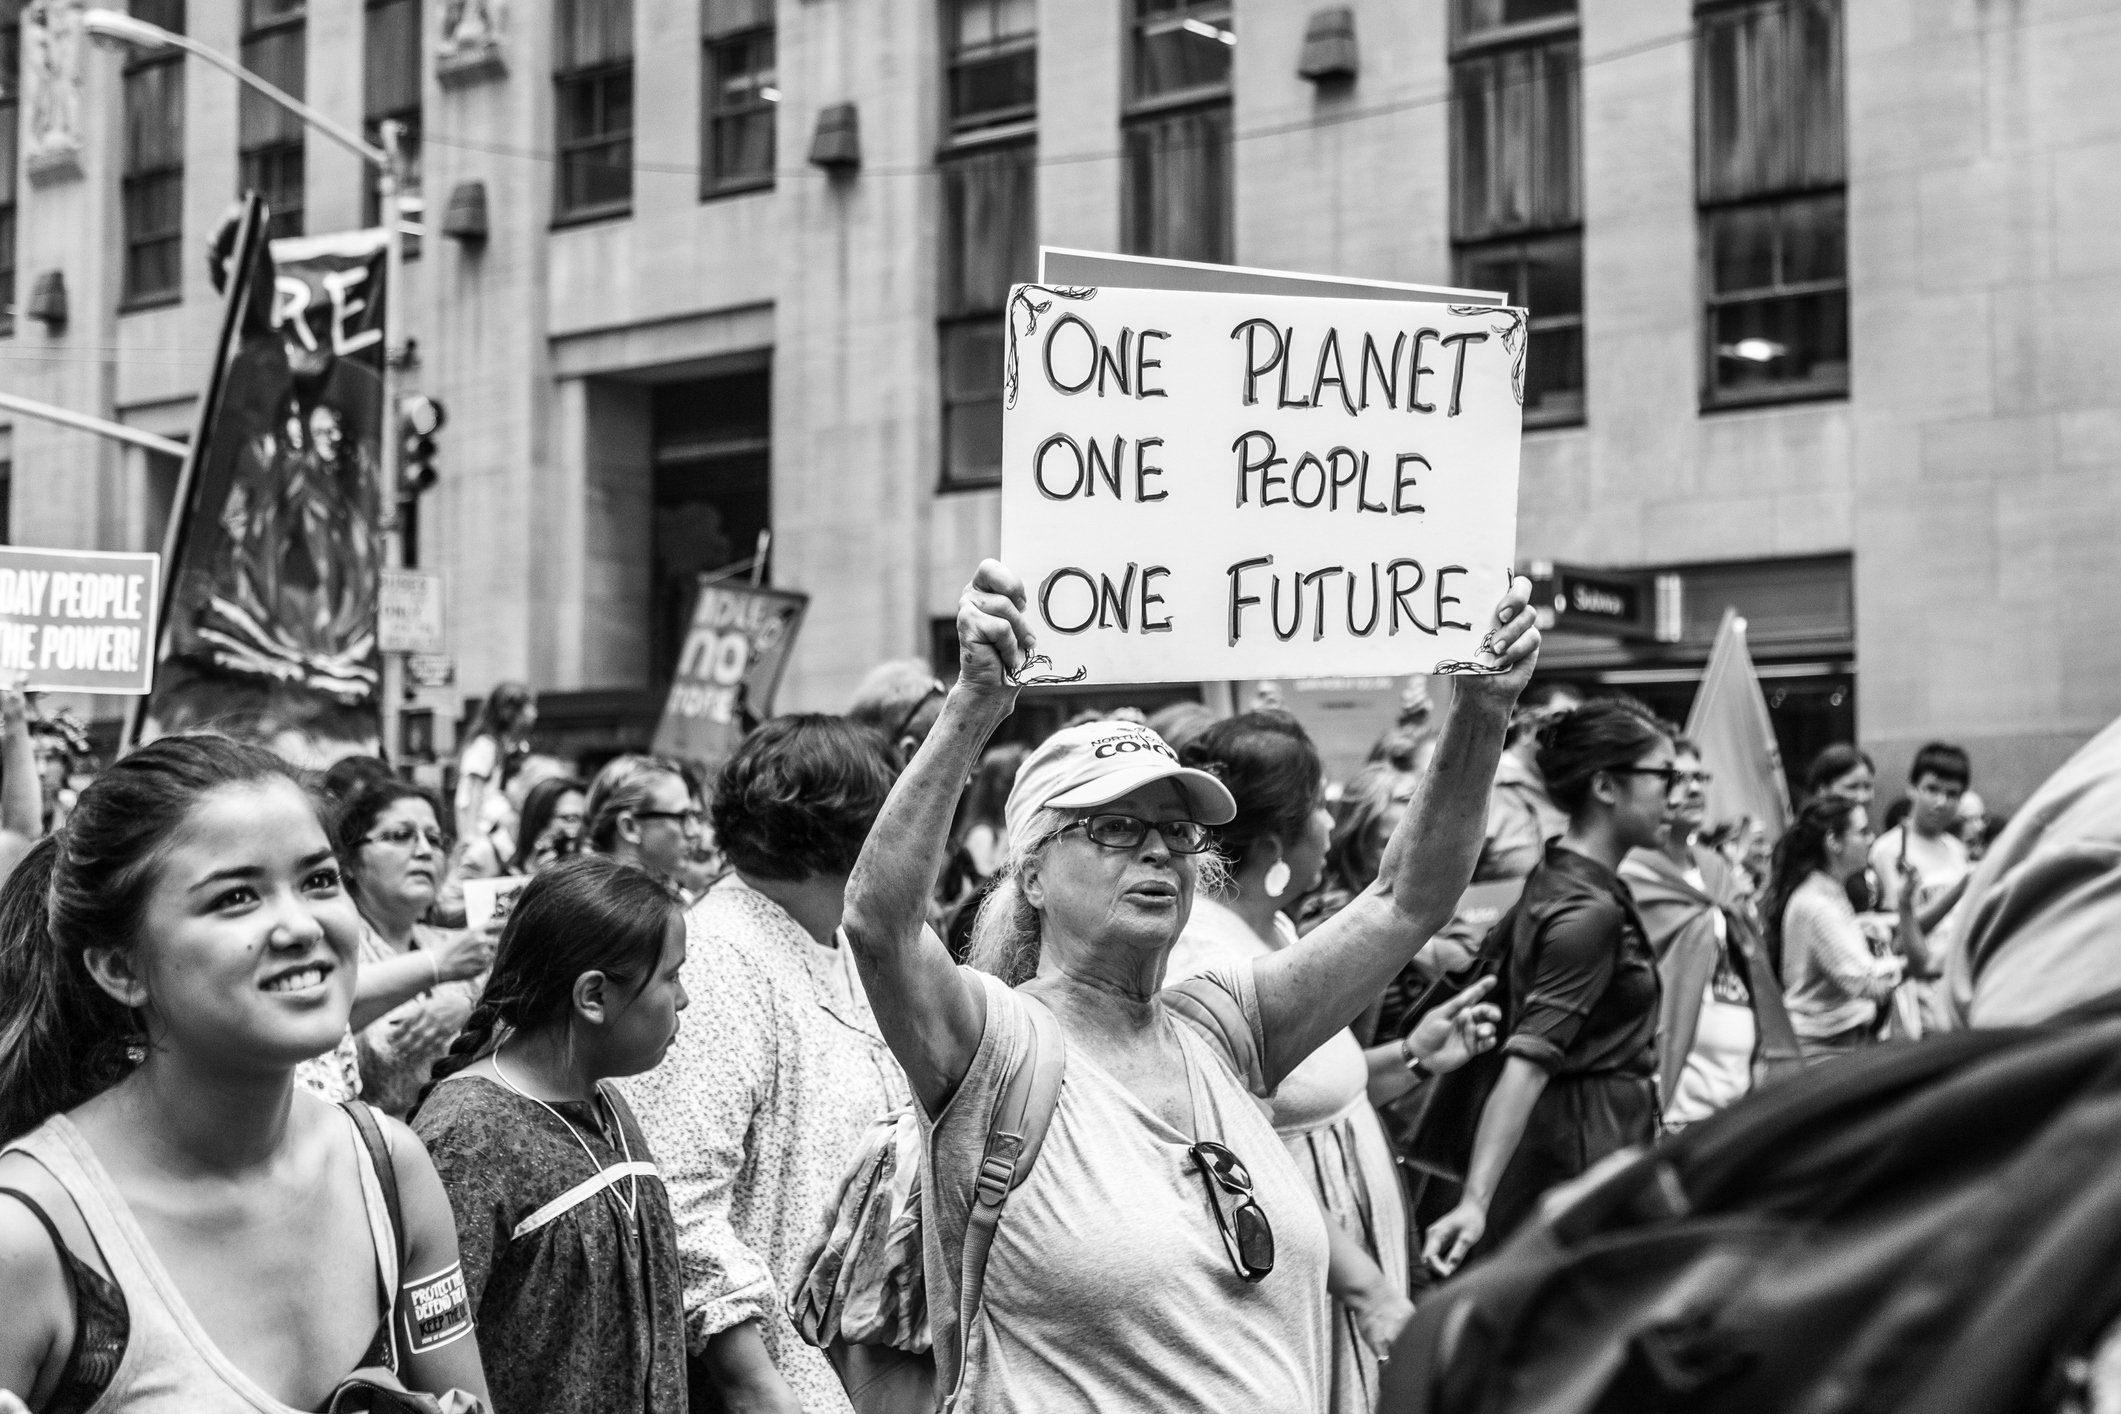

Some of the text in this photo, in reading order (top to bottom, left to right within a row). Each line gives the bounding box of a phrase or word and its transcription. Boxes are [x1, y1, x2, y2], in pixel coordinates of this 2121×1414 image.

[270, 266, 382, 356] RE
[1042, 311, 1490, 418] ONE PLANET
[1033, 430, 1432, 516] ONE PEOPLE
[50, 571, 144, 620] PEOPLE
[1039, 554, 1472, 647] ONE FUTURE
[0, 621, 141, 672] HE POWER!
[1091, 734, 1139, 747] NORTH
[411, 1278, 452, 1306] PROTECT
[415, 1294, 452, 1321] DEFEND
[419, 1315, 444, 1336] KEEP
